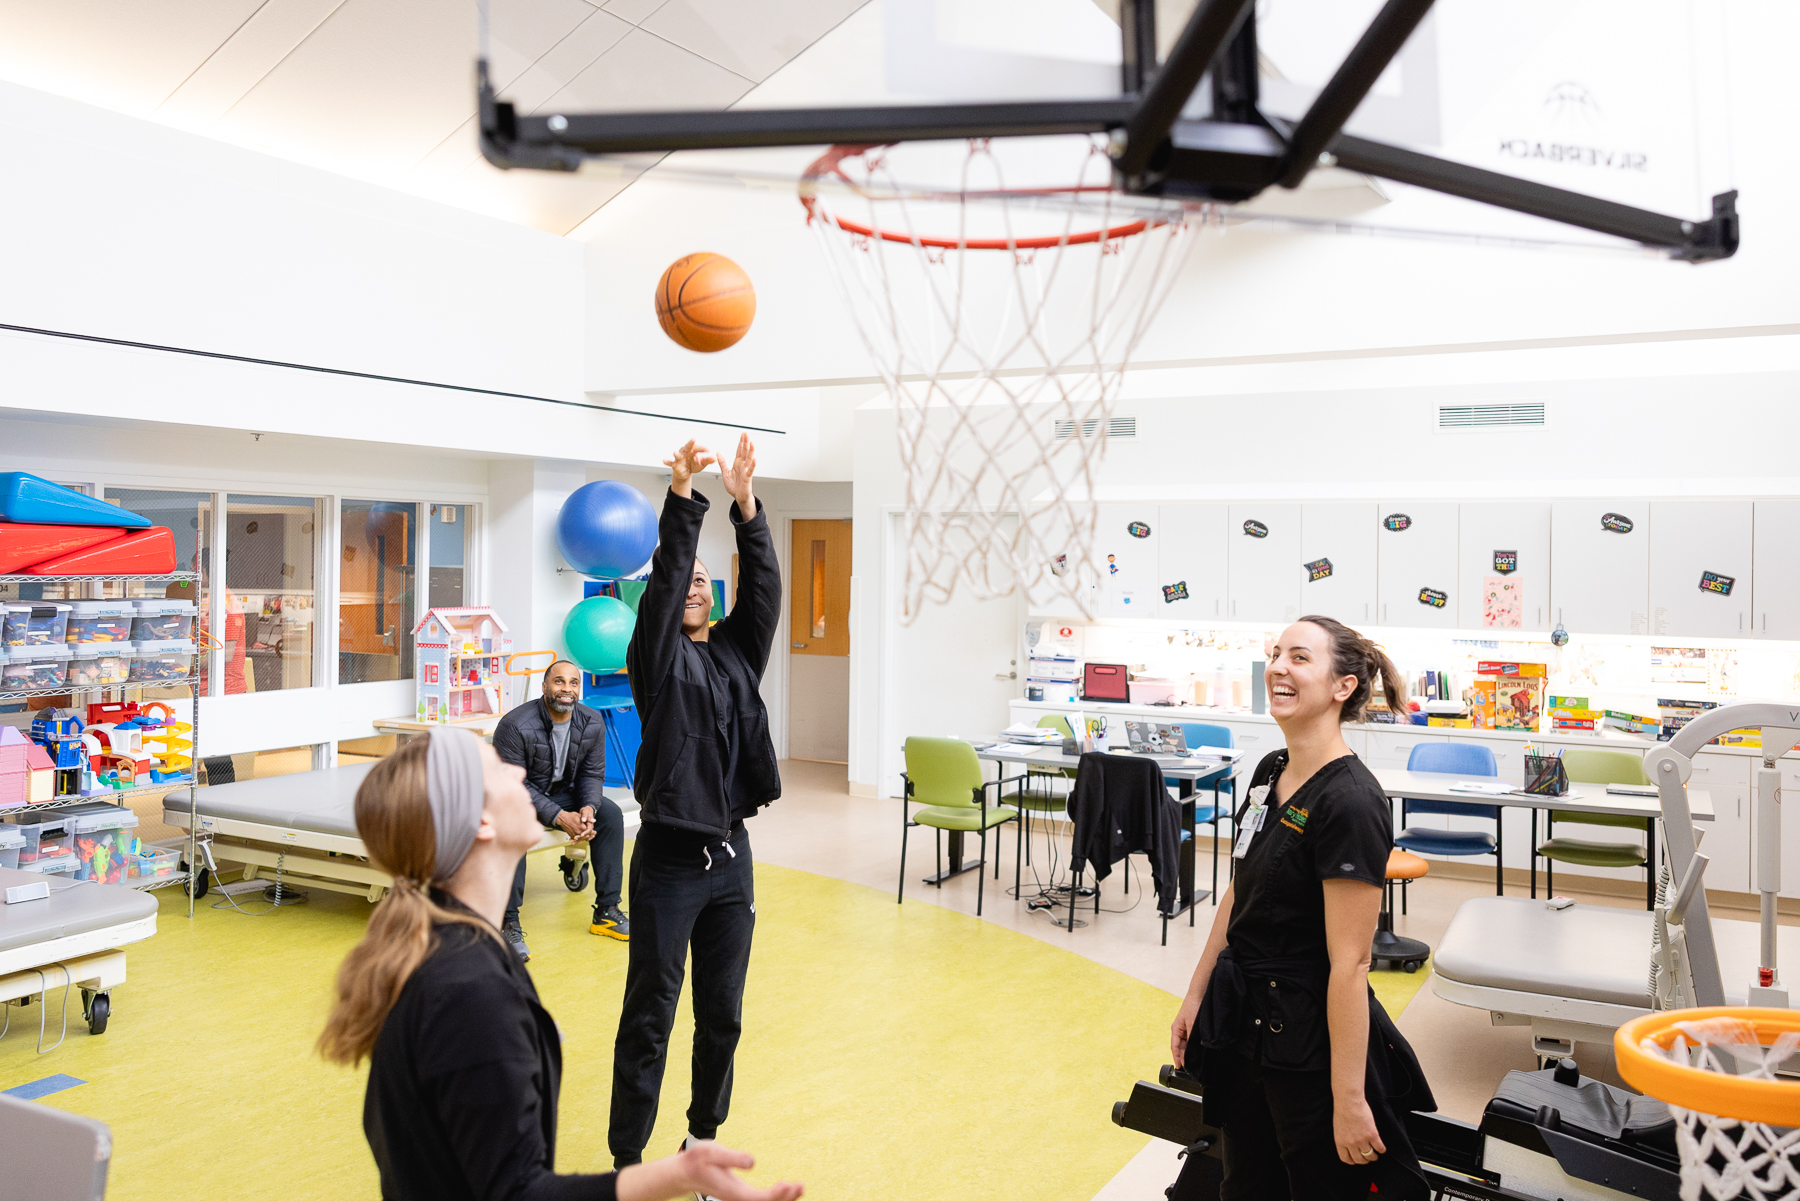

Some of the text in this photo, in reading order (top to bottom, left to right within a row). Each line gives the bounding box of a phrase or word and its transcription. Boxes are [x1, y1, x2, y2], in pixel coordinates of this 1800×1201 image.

[1389, 521, 1407, 529] BIG
[1312, 569, 1330, 580] DAY
[1704, 572, 1717, 581] DO
[1701, 579, 1730, 593] BEST
[1420, 592, 1445, 607] Happy
[1497, 681, 1539, 692] LINCOLN LOGS
[1789, 711, 1799, 722] V
[1443, 1186, 1485, 1201] Contemporary
